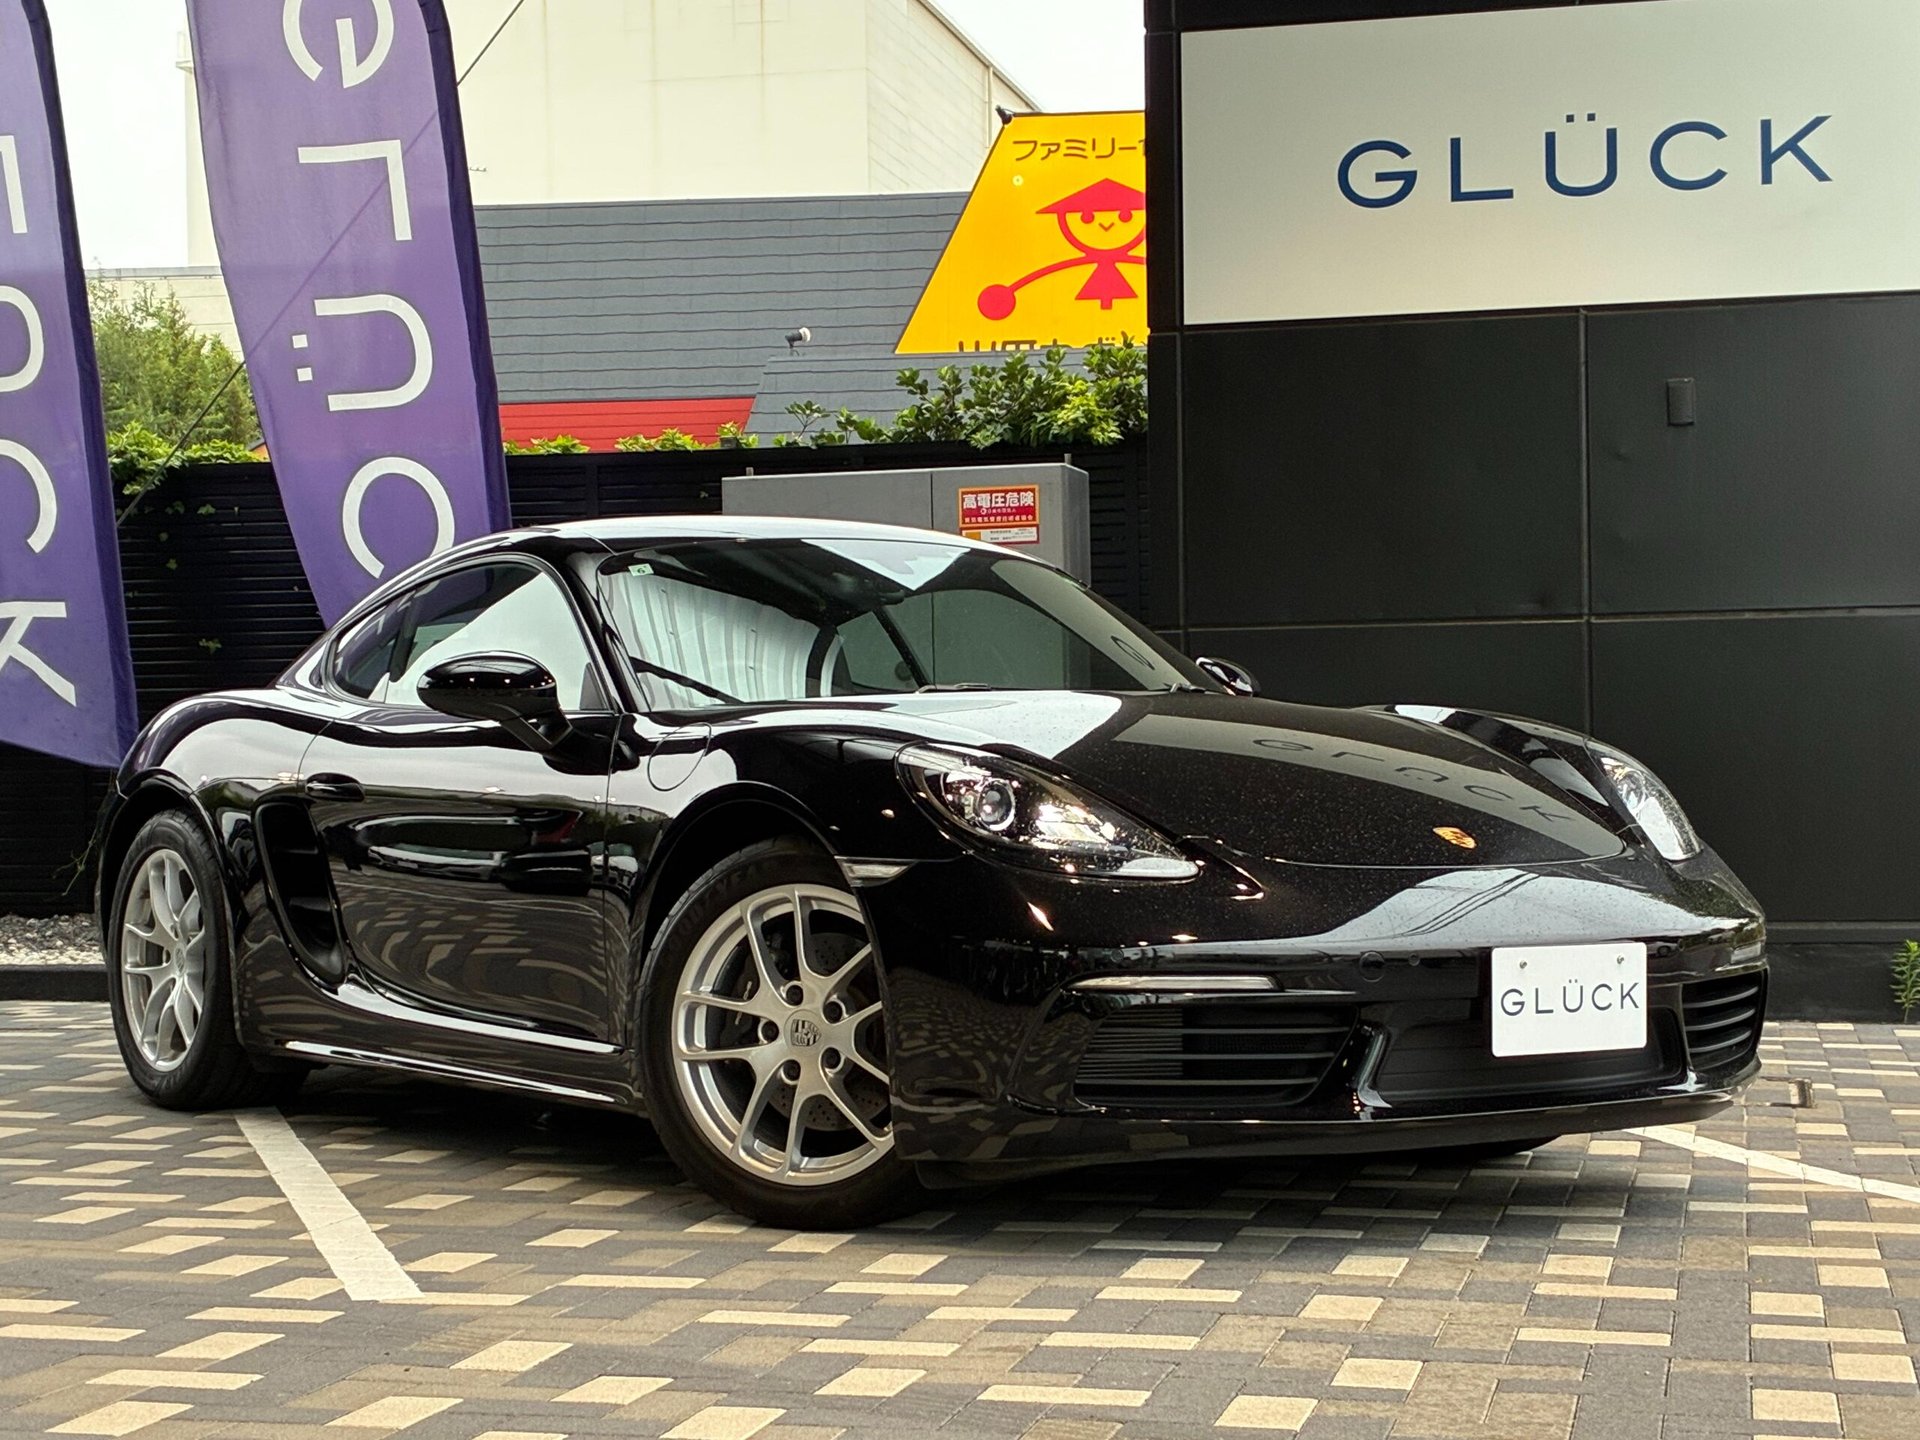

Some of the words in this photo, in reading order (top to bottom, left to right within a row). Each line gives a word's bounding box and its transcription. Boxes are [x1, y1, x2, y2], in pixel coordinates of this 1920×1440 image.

[1012, 137, 1145, 161] ファミリー
[1336, 112, 1833, 209] GLÜCK
[962, 491, 1034, 509] 高電圧危険
[1500, 979, 1640, 1017] GLÜCK
